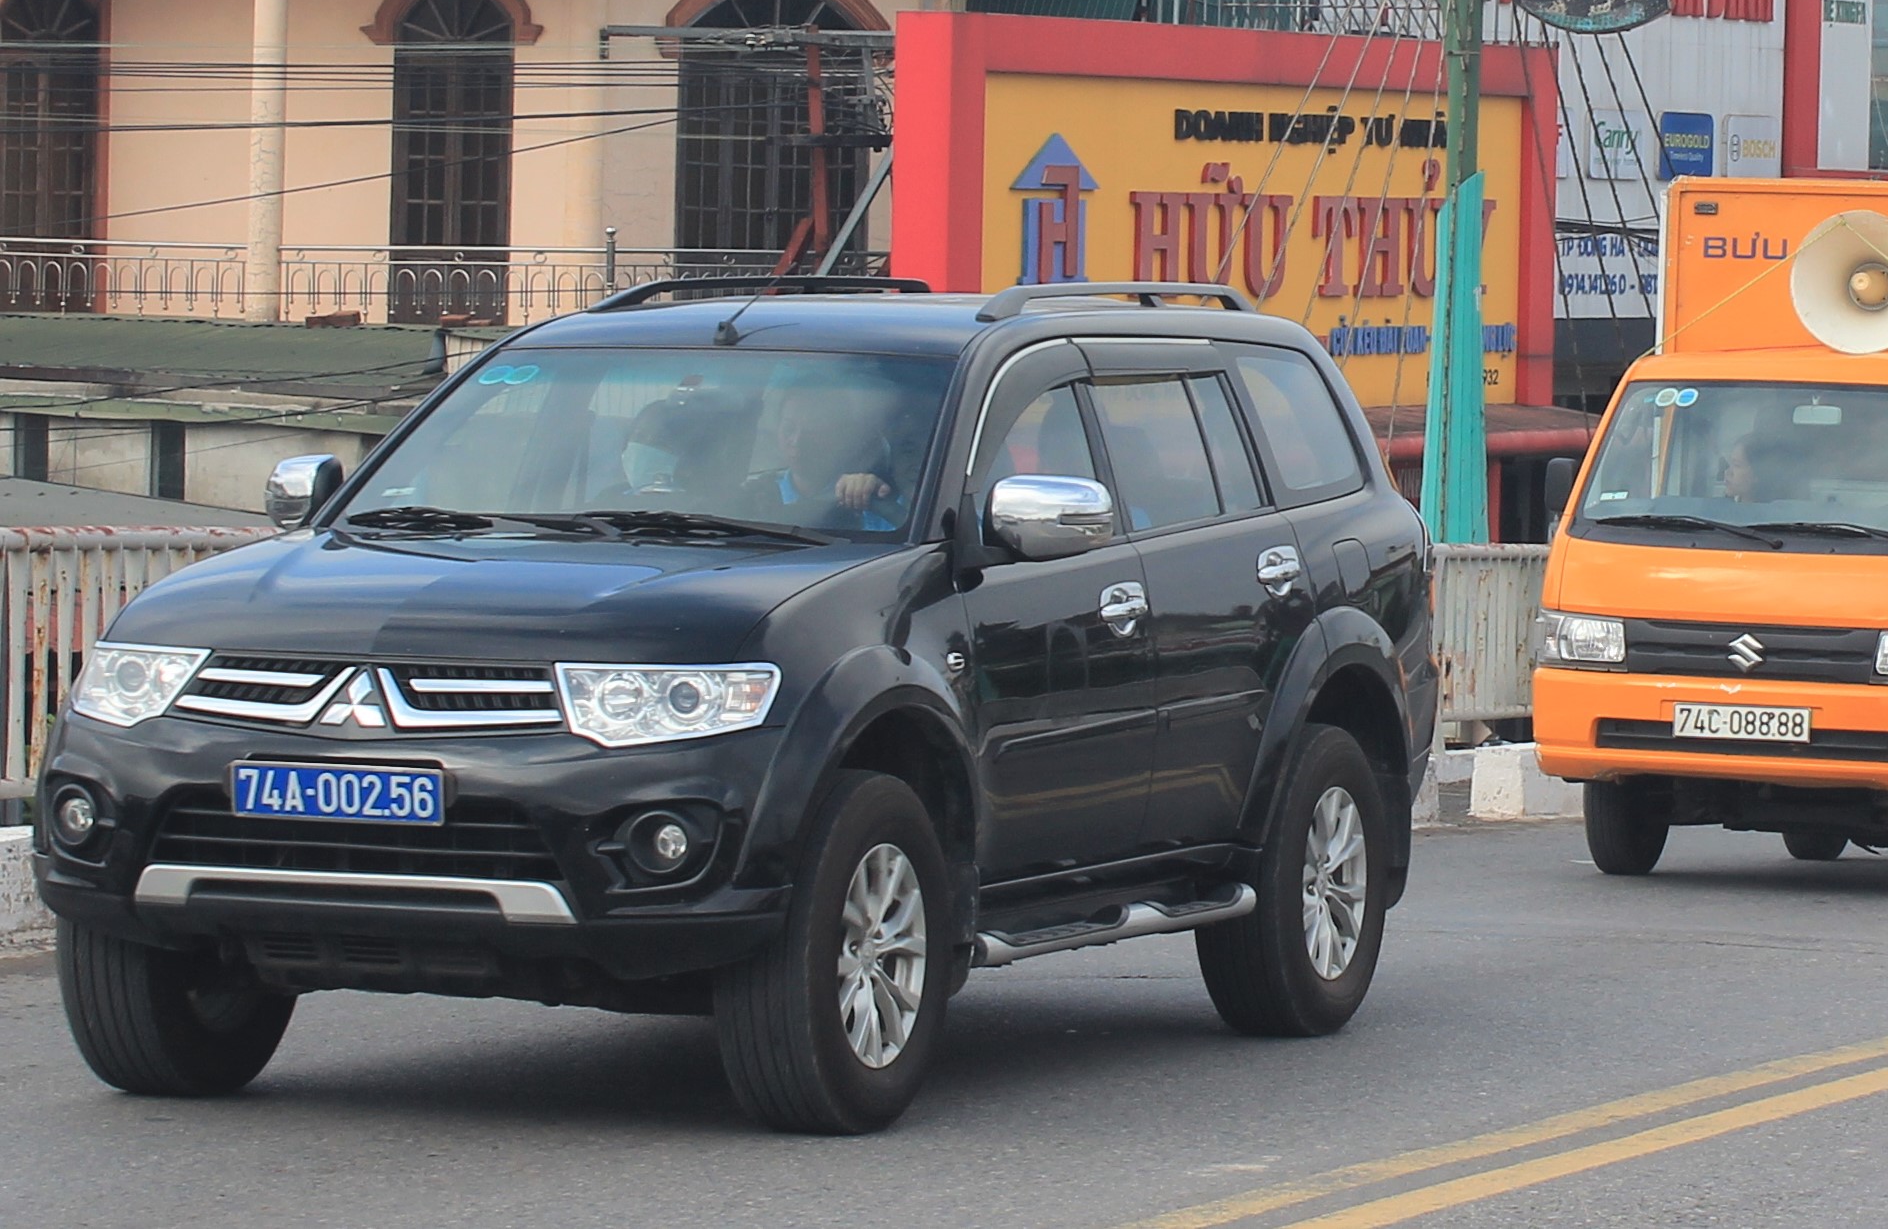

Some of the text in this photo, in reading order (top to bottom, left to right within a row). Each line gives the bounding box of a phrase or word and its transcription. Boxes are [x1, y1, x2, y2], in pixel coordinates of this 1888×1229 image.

[1174, 108, 1264, 142] DOANH
[1269, 105, 1356, 155] NGHIỆP
[1360, 113, 1396, 148] TƯ
[1663, 133, 1711, 149] EUROGOLD
[1742, 139, 1776, 159] BOSCH
[1129, 161, 1294, 300] HỮU
[1703, 232, 1789, 260] BƯU
[1679, 707, 1805, 737] 74C-088.88
[238, 768, 435, 819] 74A-002.56
